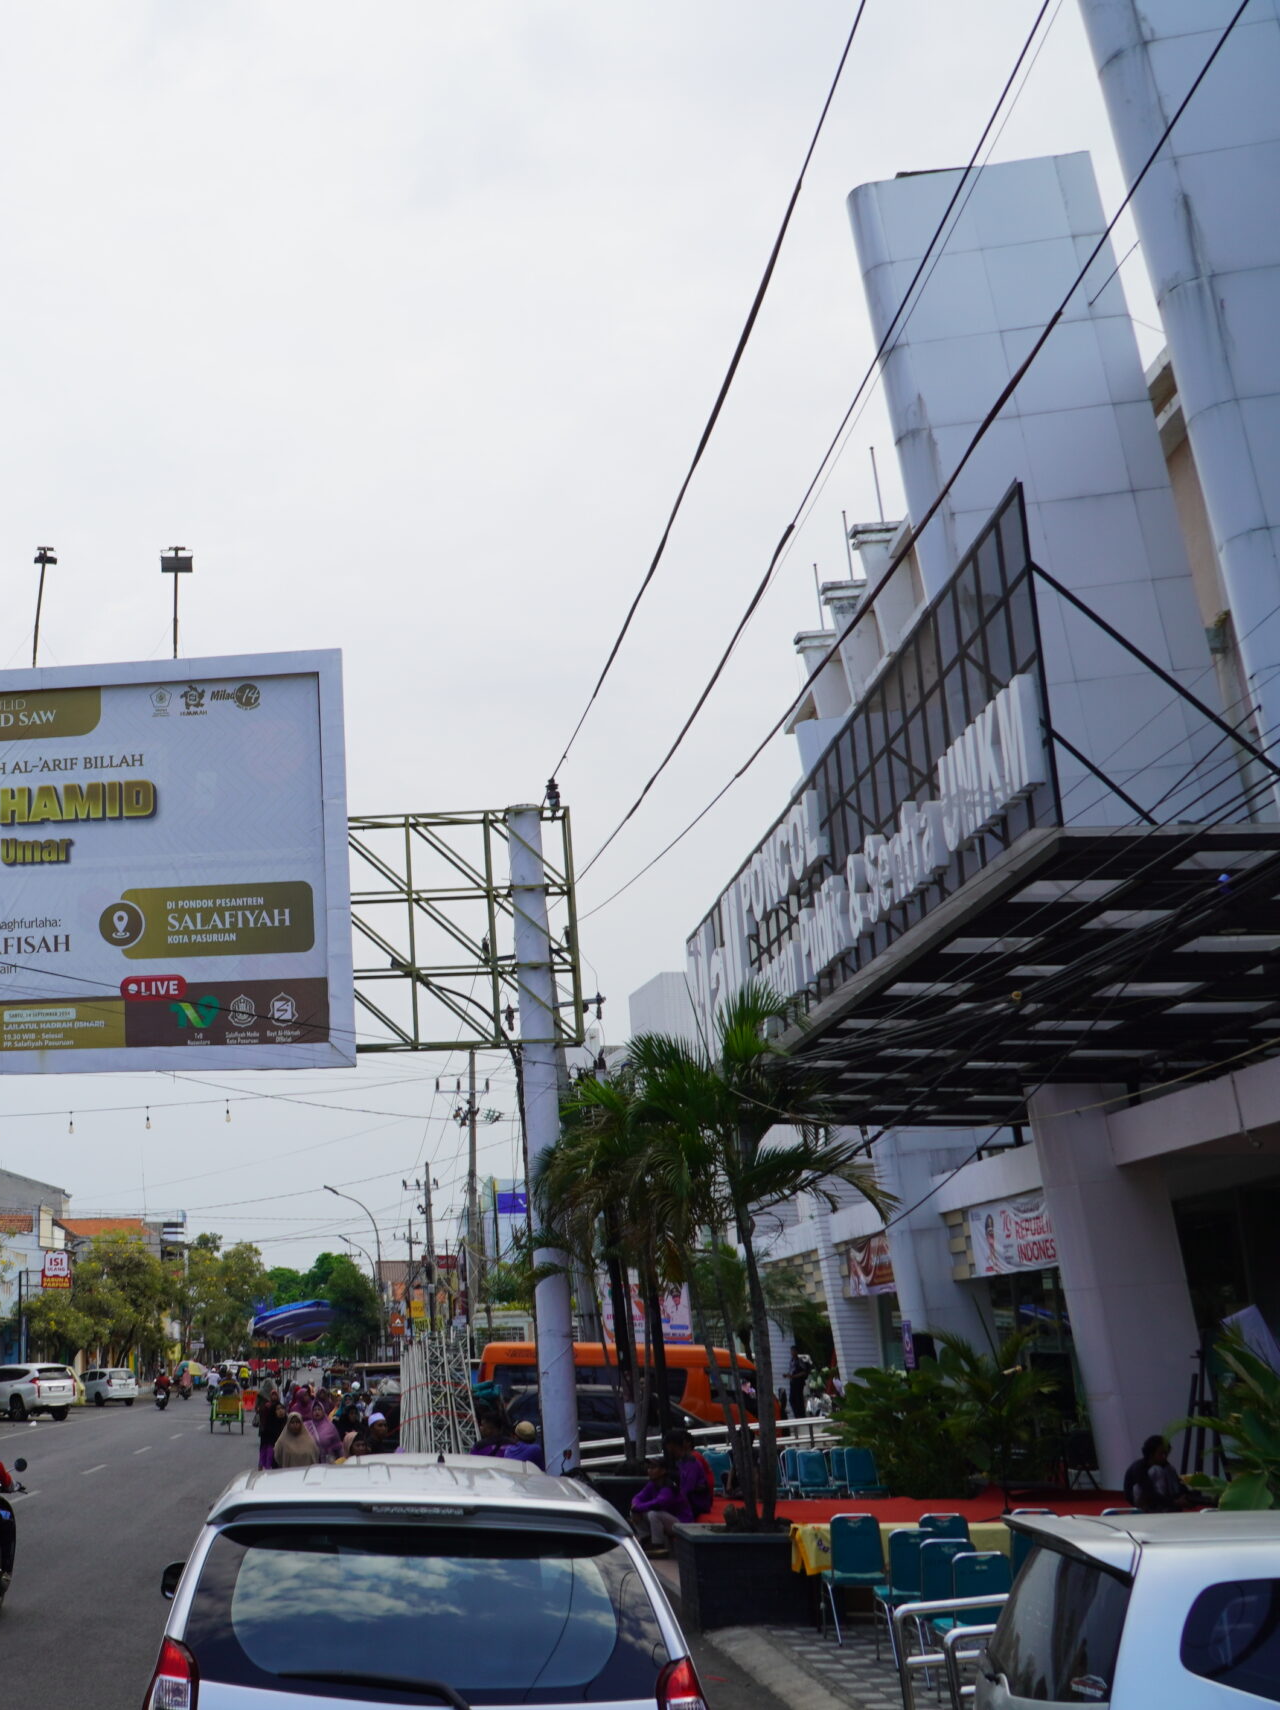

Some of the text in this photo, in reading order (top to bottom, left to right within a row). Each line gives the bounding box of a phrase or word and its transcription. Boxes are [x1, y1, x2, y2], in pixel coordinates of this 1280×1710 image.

[242, 687, 259, 704] 14
[18, 709, 57, 726] SAW
[82, 754, 144, 770] BILLAH
[799, 673, 1047, 984] Publik & Sentra UMKM
[0, 836, 74, 866] Umar
[739, 789, 831, 937] PONCOL
[166, 897, 264, 909] DI PONDOK PESANTREN
[167, 908, 291, 931] SALAFIYAH
[167, 932, 237, 944] KOTA PASURUAN
[141, 980, 179, 996] LIVE
[3, 1023, 40, 1031] LAILATUL
[22, 1032, 36, 1040] WIB
[41, 1031, 64, 1040] Selesai
[14, 1040, 43, 1049] Salafiyah
[44, 1039, 74, 1047] Pasuruan
[49, 1257, 64, 1266] ISI
